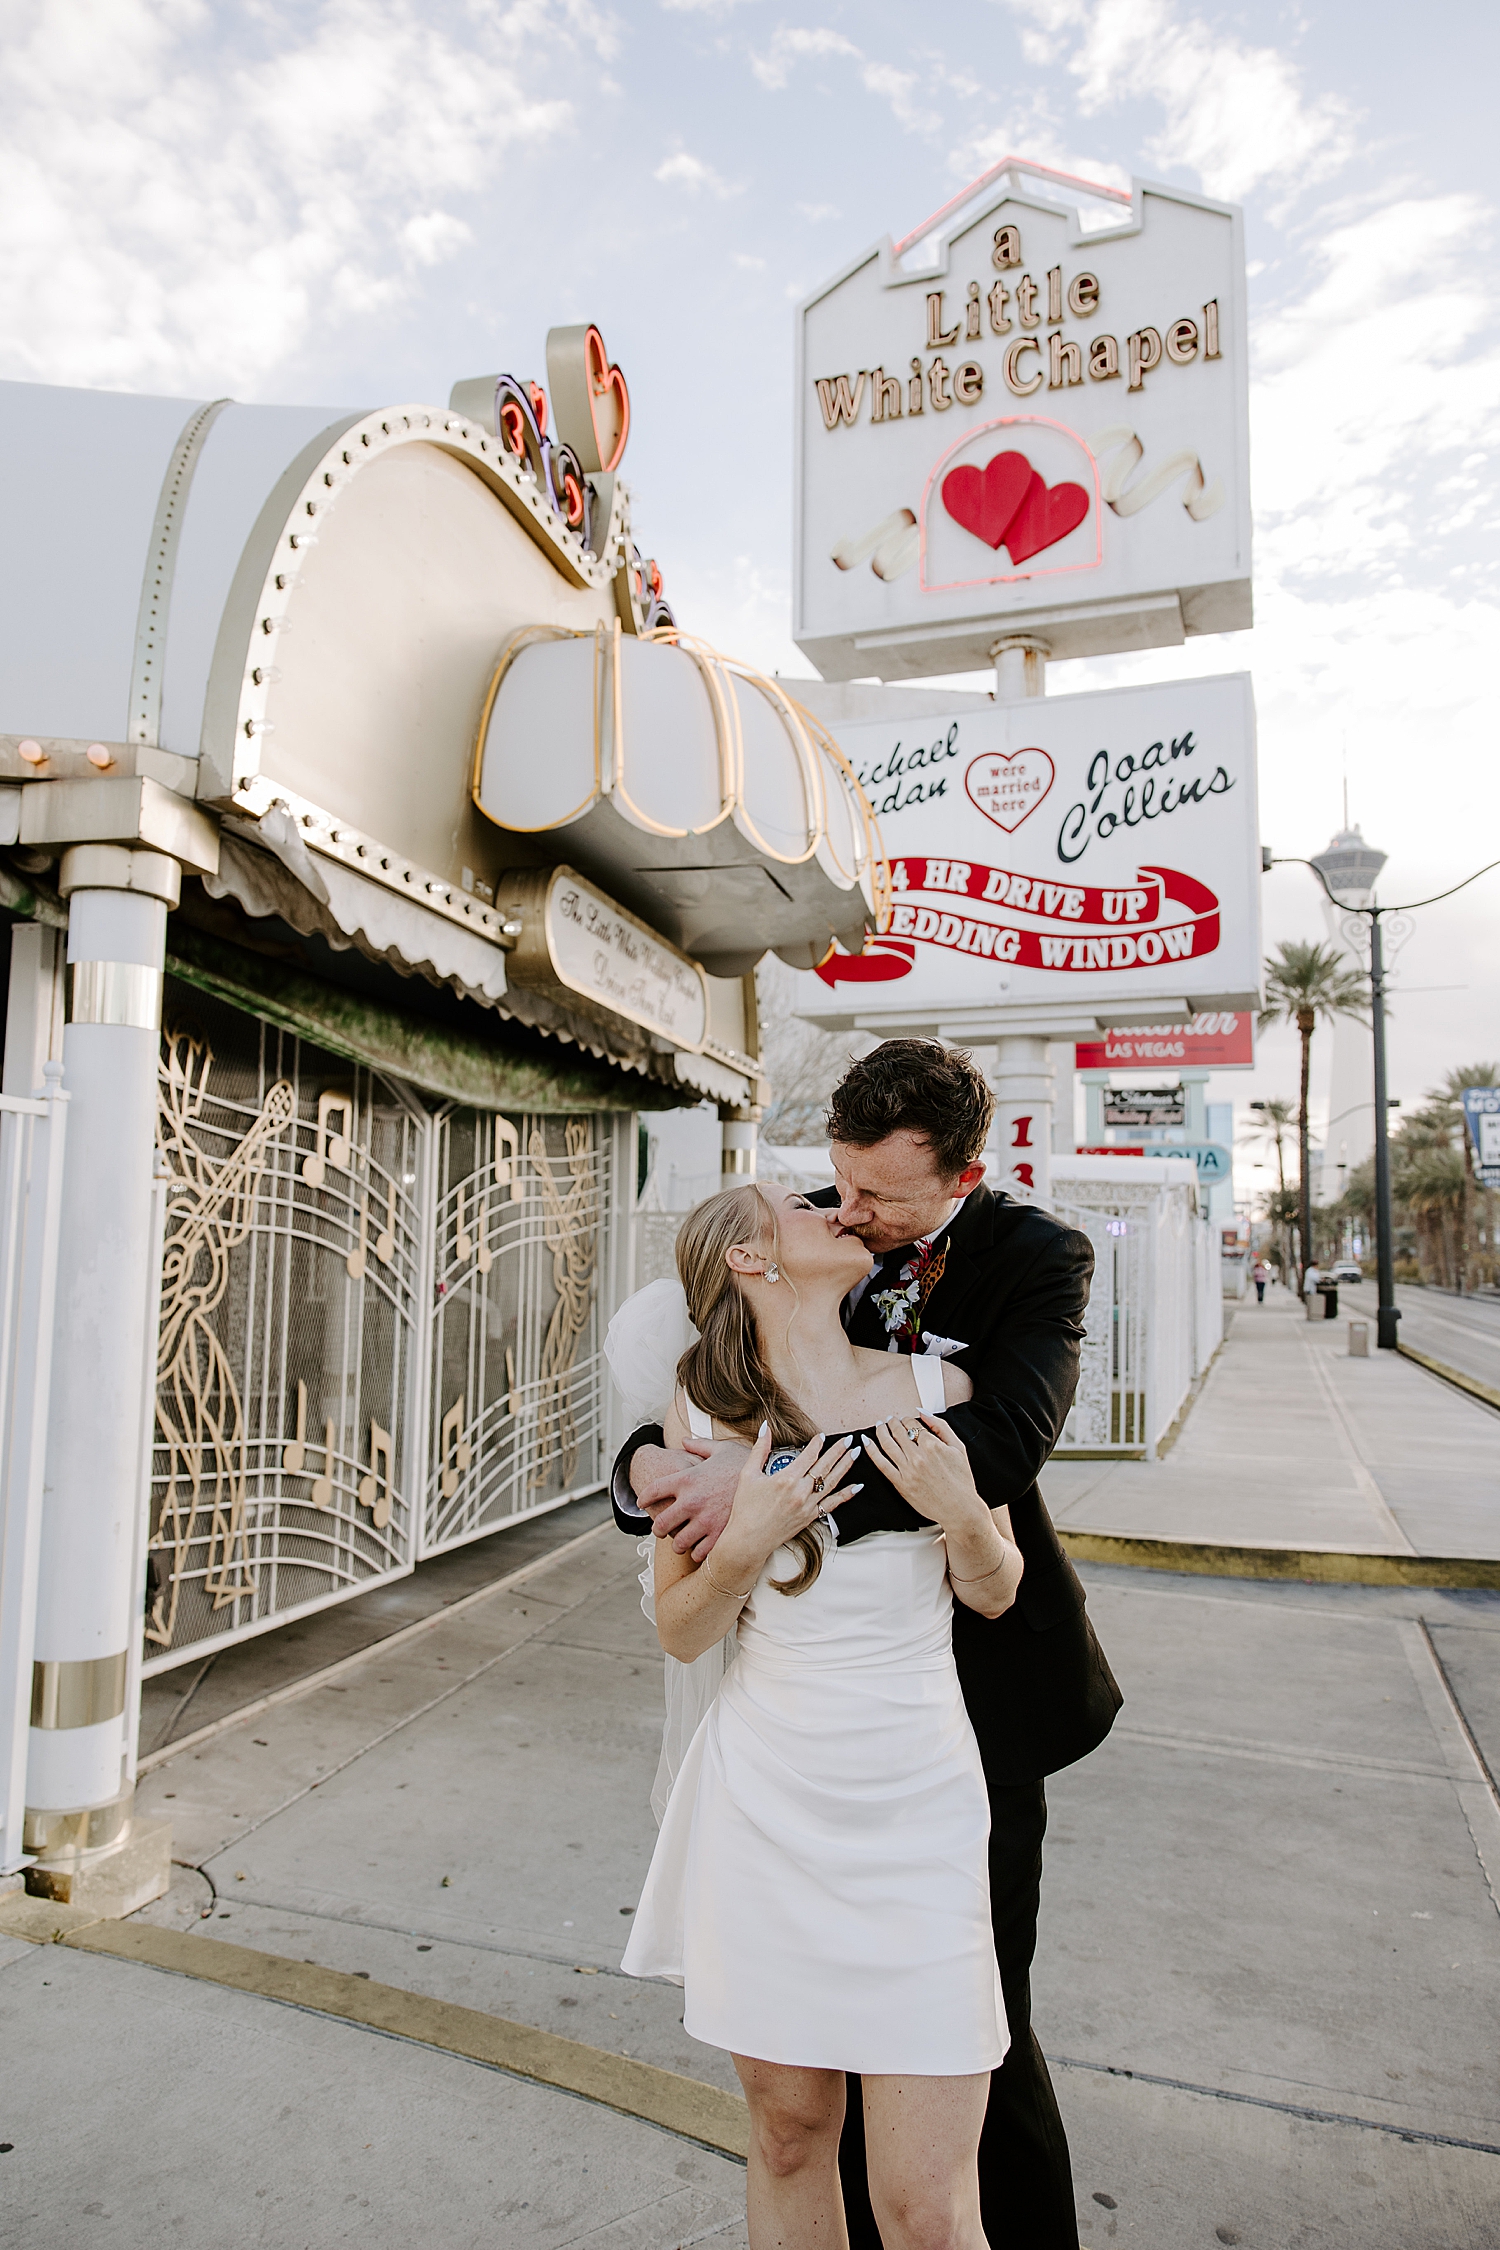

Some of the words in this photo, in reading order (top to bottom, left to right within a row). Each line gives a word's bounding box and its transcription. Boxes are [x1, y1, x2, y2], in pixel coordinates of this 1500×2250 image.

[991, 225, 1023, 270] a
[924, 266, 1099, 346] Little
[815, 357, 984, 430] White
[1003, 298, 1222, 395] Chapel
[841, 721, 958, 790] ichael
[990, 765, 1026, 777] were
[1087, 730, 1199, 814] Joan
[977, 777, 1040, 797] married
[991, 799, 1025, 812] here
[1056, 765, 1237, 864] Collins
[923, 860, 971, 893] HR
[982, 869, 1086, 921] DRIVE
[1100, 887, 1149, 923] UP
[1039, 925, 1195, 970] WINDOW
[1105, 1042, 1132, 1058] LAS
[1134, 1041, 1185, 1058] VEGAS
